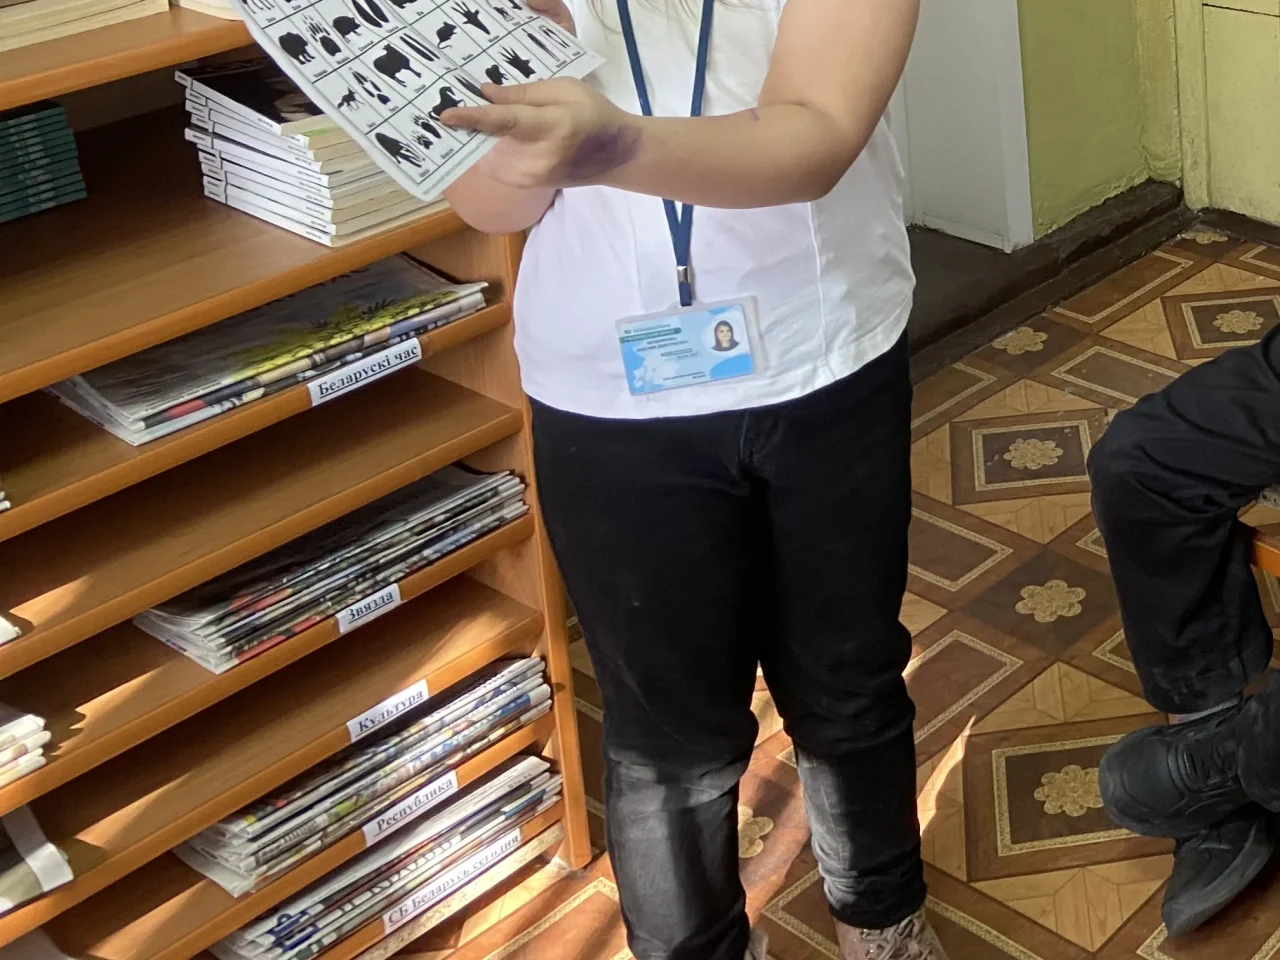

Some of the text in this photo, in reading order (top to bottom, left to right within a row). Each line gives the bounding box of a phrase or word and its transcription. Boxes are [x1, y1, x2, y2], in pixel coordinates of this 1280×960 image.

[318, 346, 418, 395] Беларускі час
[347, 592, 393, 620] Звязда
[357, 690, 423, 732] Культура
[376, 778, 453, 831] Республика
[389, 904, 408, 924] СБ
[412, 869, 470, 908] Беларусь
[473, 835, 519, 869] сегодня
